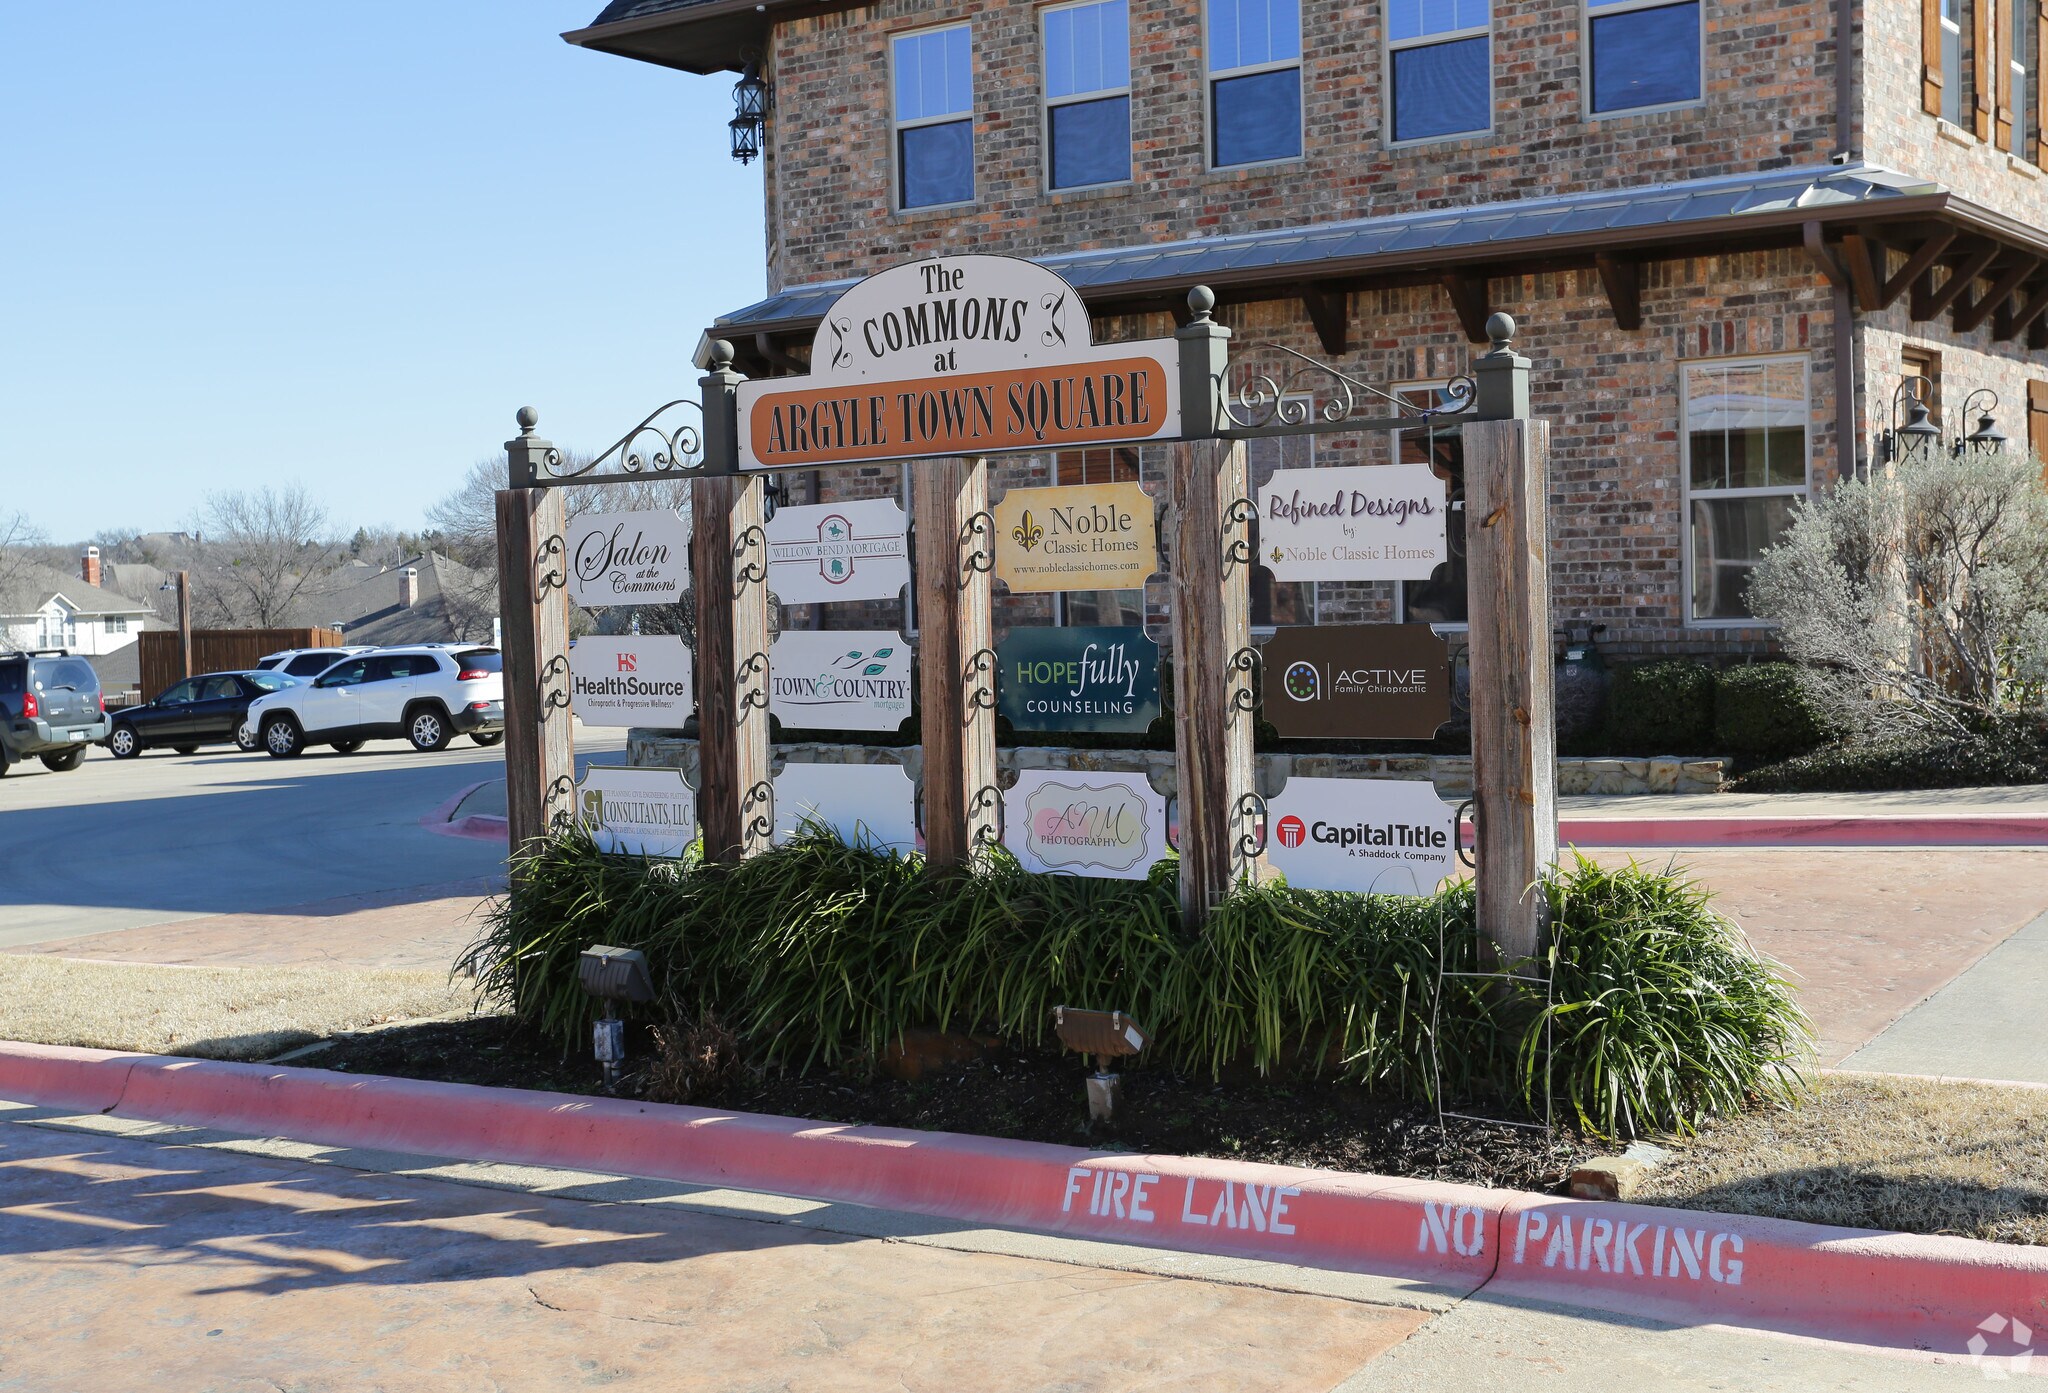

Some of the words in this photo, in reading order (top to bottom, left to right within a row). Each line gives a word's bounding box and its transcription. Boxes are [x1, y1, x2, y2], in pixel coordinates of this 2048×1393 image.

[920, 263, 964, 295] The
[863, 297, 1028, 358] COMMONS
[933, 347, 958, 371] at
[765, 395, 888, 455] ARGYLE
[896, 385, 996, 444] TOWN
[1007, 370, 1151, 440] SQUARE
[1269, 489, 1345, 526] Refined
[1350, 490, 1435, 526] Designs
[1050, 504, 1132, 535] Noble
[772, 547, 813, 558] WILLOW
[817, 545, 844, 556] BEND
[846, 541, 901, 555] MORTGAGE
[1044, 539, 1088, 554] Classic
[1091, 538, 1139, 553] Homes
[1286, 547, 1327, 562] Noble
[1332, 546, 1380, 561] Classic
[1384, 546, 1435, 560] Homes
[575, 523, 672, 594] Salon
[1014, 561, 1140, 574] www.nobleclassichomes.com
[636, 570, 645, 579] at
[646, 566, 660, 579] the
[609, 571, 676, 594] Commons
[1017, 643, 1140, 697] HOPEfully
[1335, 669, 1427, 685] ACTIVE
[575, 676, 684, 696] HealthSource
[1335, 685, 1364, 695] Family
[1367, 685, 1427, 695] Chiropractic
[587, 698, 616, 708] Chiropractic
[622, 699, 650, 709] Progressive
[873, 701, 905, 711] mortgages
[1026, 700, 1133, 714] COUNSELING
[604, 800, 672, 828] CONSULTANTS,
[672, 803, 690, 826] LLC
[1040, 835, 1118, 847] PHOTOGRAPHY
[1348, 848, 1356, 857] A
[1359, 849, 1401, 860] Shaddock
[1404, 851, 1447, 864] Company
[1062, 1167, 1159, 1223] FIRE
[1182, 1177, 1301, 1236] LANE
[1419, 1200, 1485, 1257] NO
[1514, 1209, 1744, 1285] PARKING
